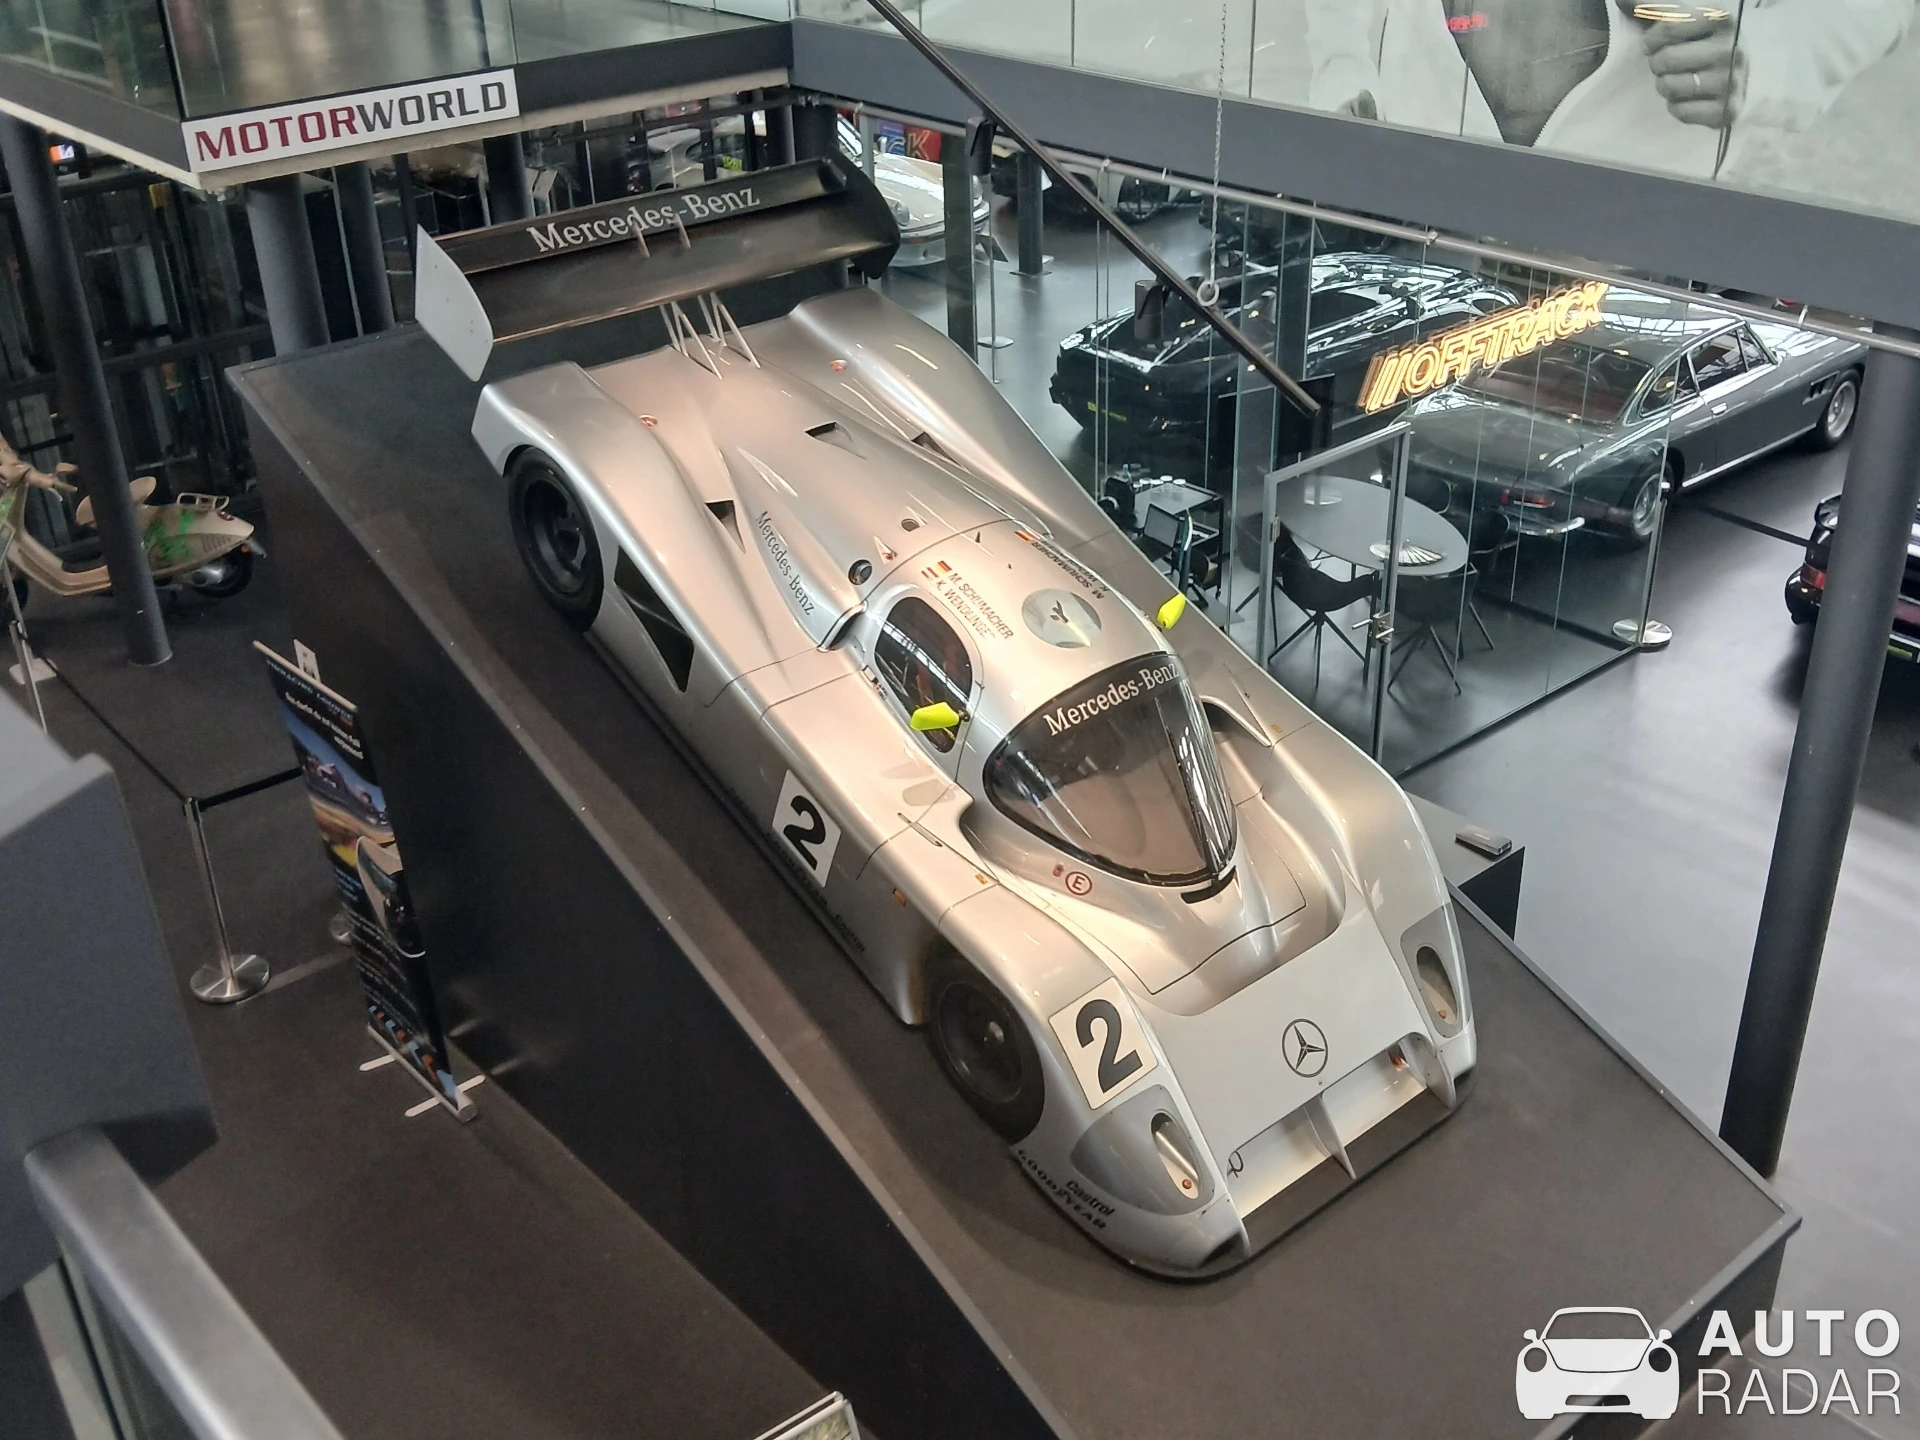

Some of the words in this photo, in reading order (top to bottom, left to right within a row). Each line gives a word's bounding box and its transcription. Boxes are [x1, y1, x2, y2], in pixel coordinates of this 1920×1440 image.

[195, 81, 508, 162] MOTORWORLD
[526, 187, 761, 253] Mercedes-Benz
[755, 510, 816, 616] Mercedes-Benz
[1043, 662, 1181, 737] Mercedes-Benz
[783, 795, 826, 871] 2
[1075, 999, 1143, 1094] 2
[1066, 1179, 1116, 1217] Castrol
